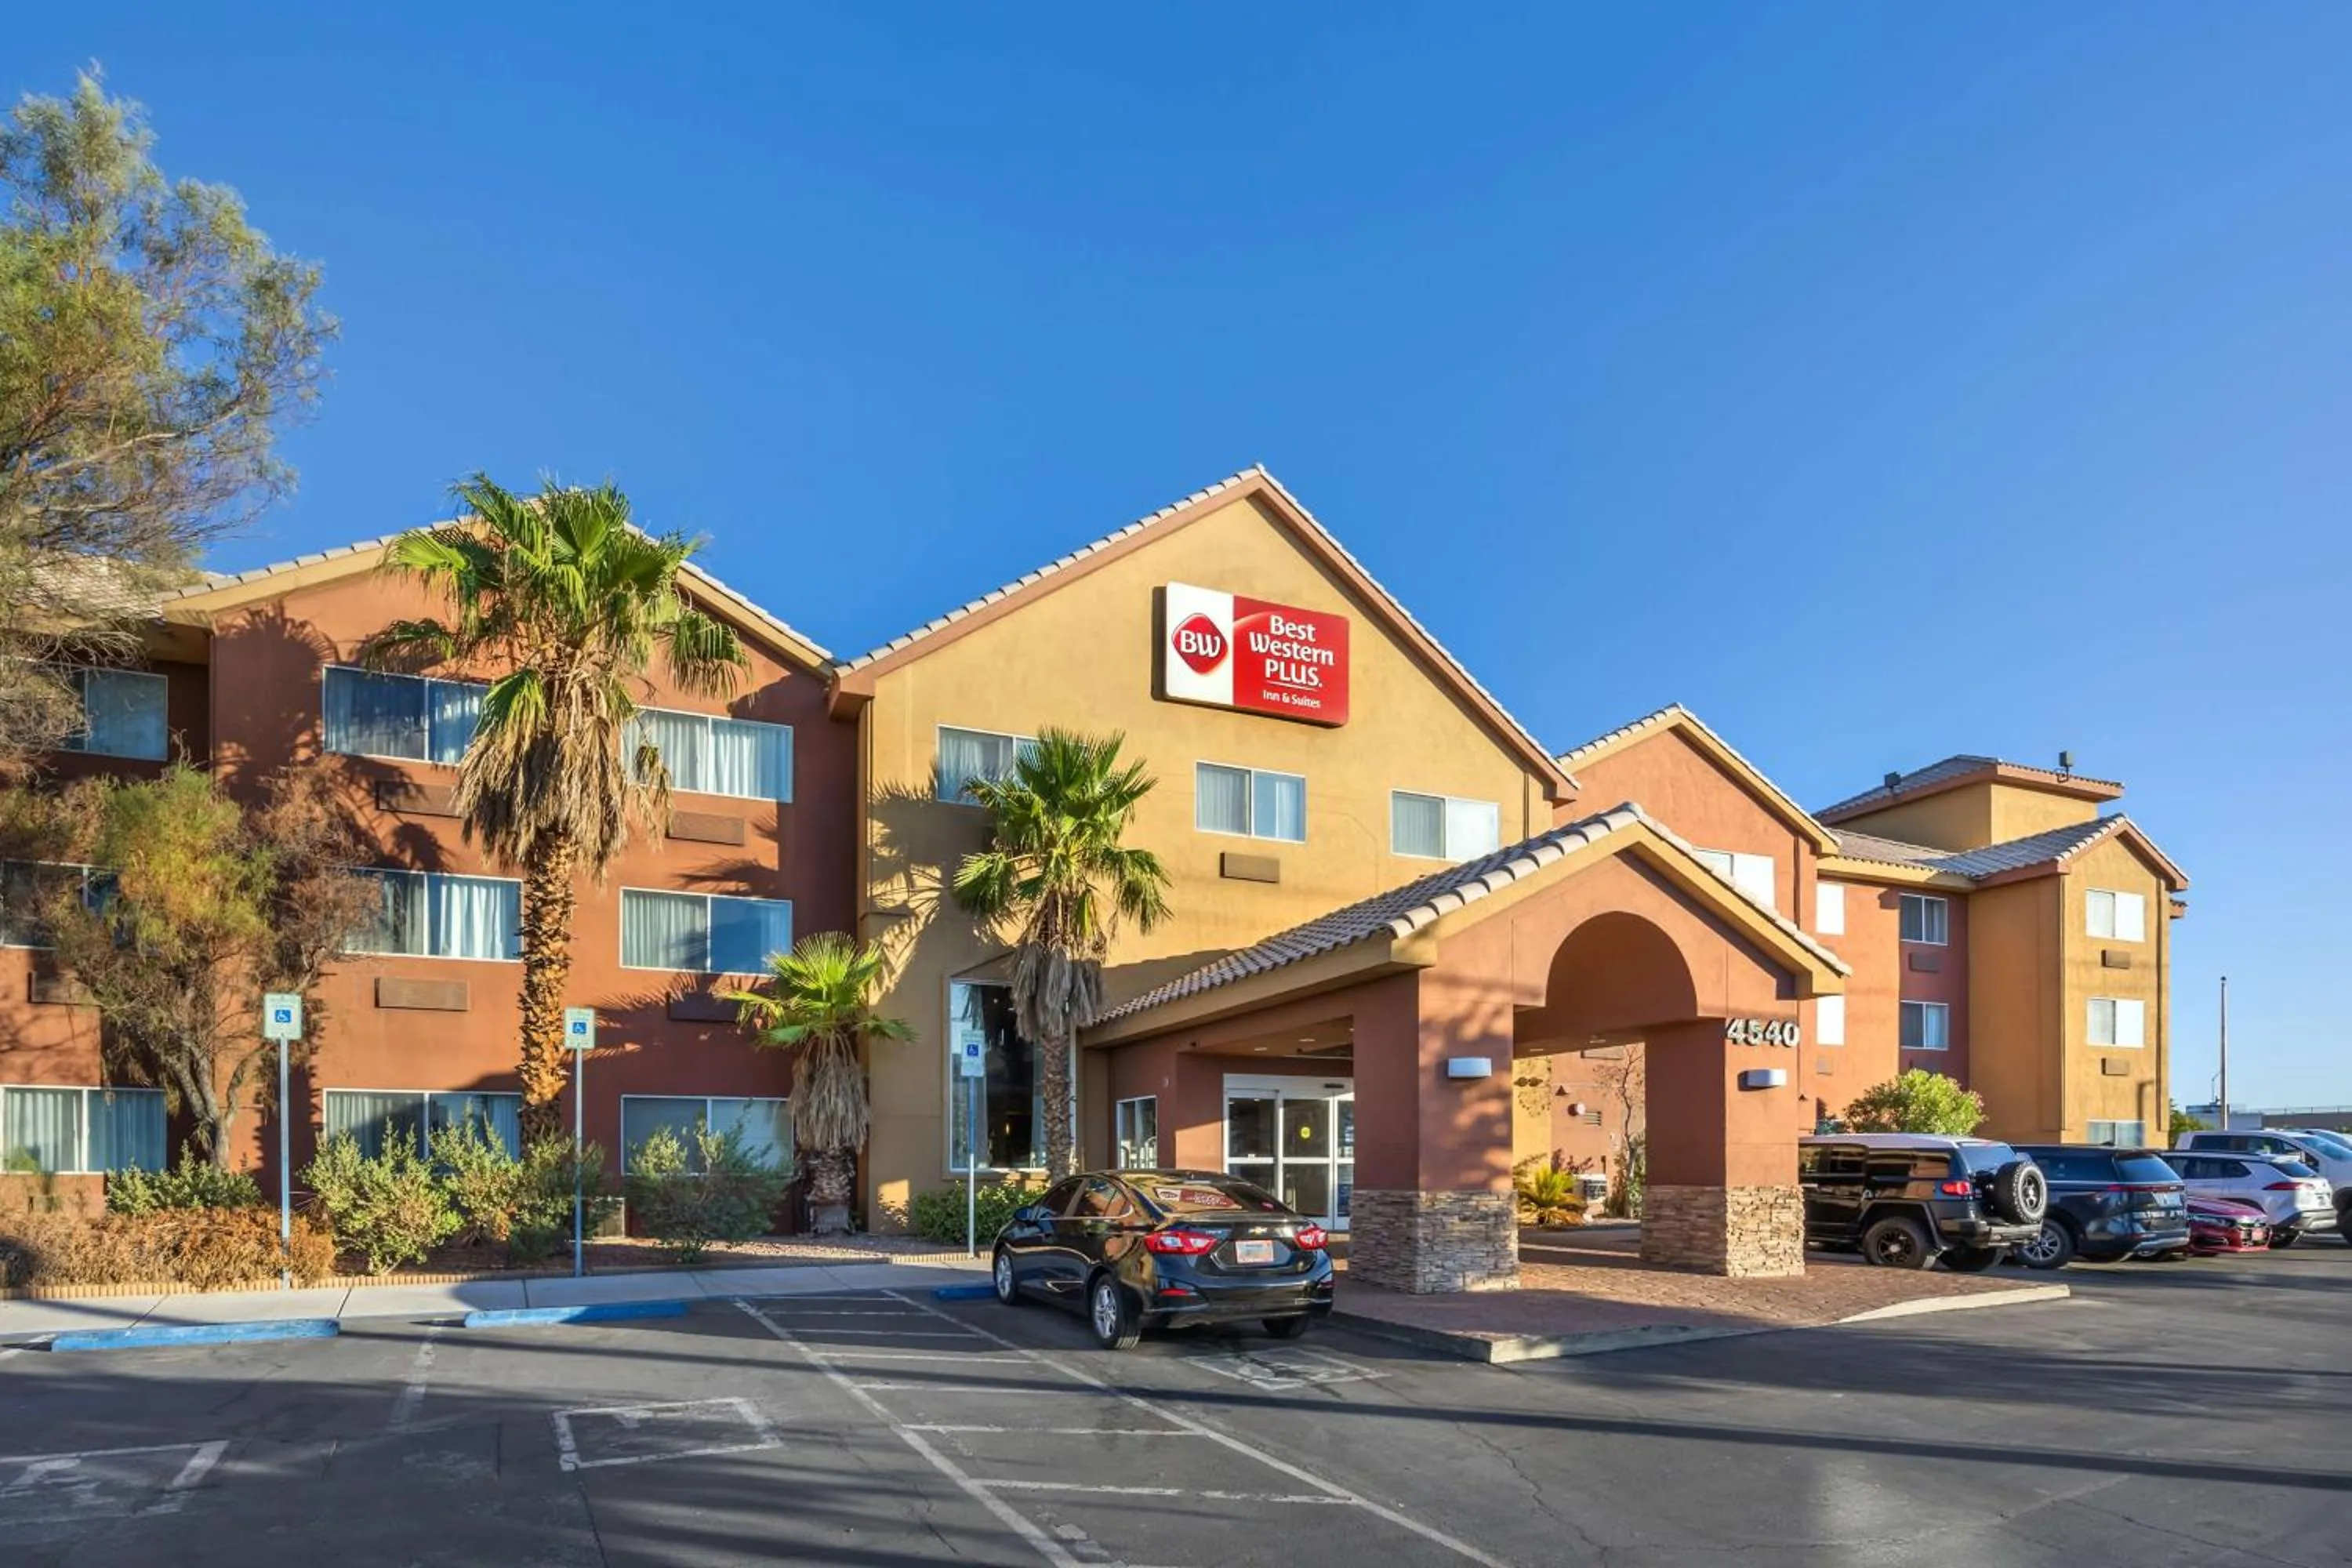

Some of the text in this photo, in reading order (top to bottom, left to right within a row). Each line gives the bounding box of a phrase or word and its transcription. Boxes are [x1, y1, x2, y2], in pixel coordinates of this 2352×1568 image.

[1270, 614, 1316, 642] Best
[1180, 630, 1221, 658] BW
[1249, 632, 1334, 666] Western
[1263, 690, 1321, 709] Inn & Suites
[1726, 1018, 1800, 1047] 4540
